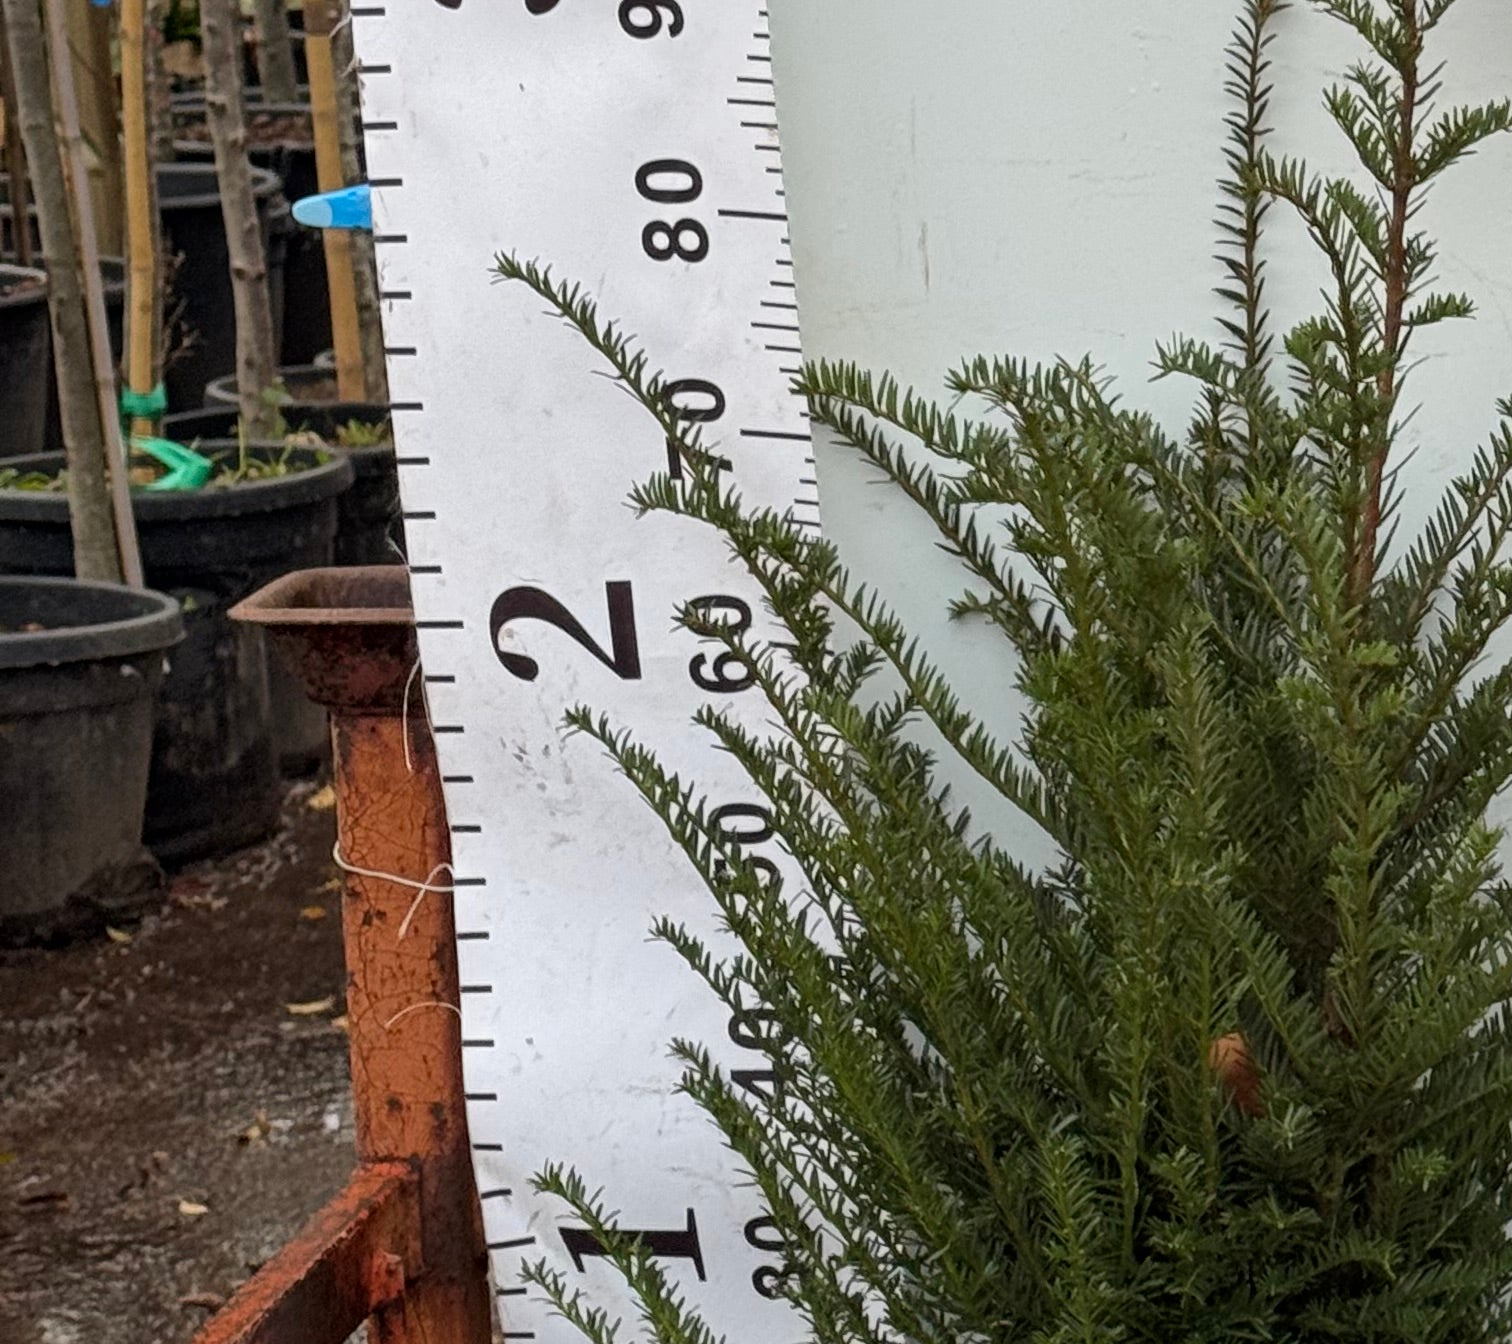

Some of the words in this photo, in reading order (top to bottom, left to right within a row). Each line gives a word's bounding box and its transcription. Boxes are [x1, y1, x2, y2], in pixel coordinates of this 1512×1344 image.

[634, 158, 709, 263] 80
[489, 580, 642, 682] 2
[688, 595, 753, 693] 60
[558, 1207, 706, 1282] 1
